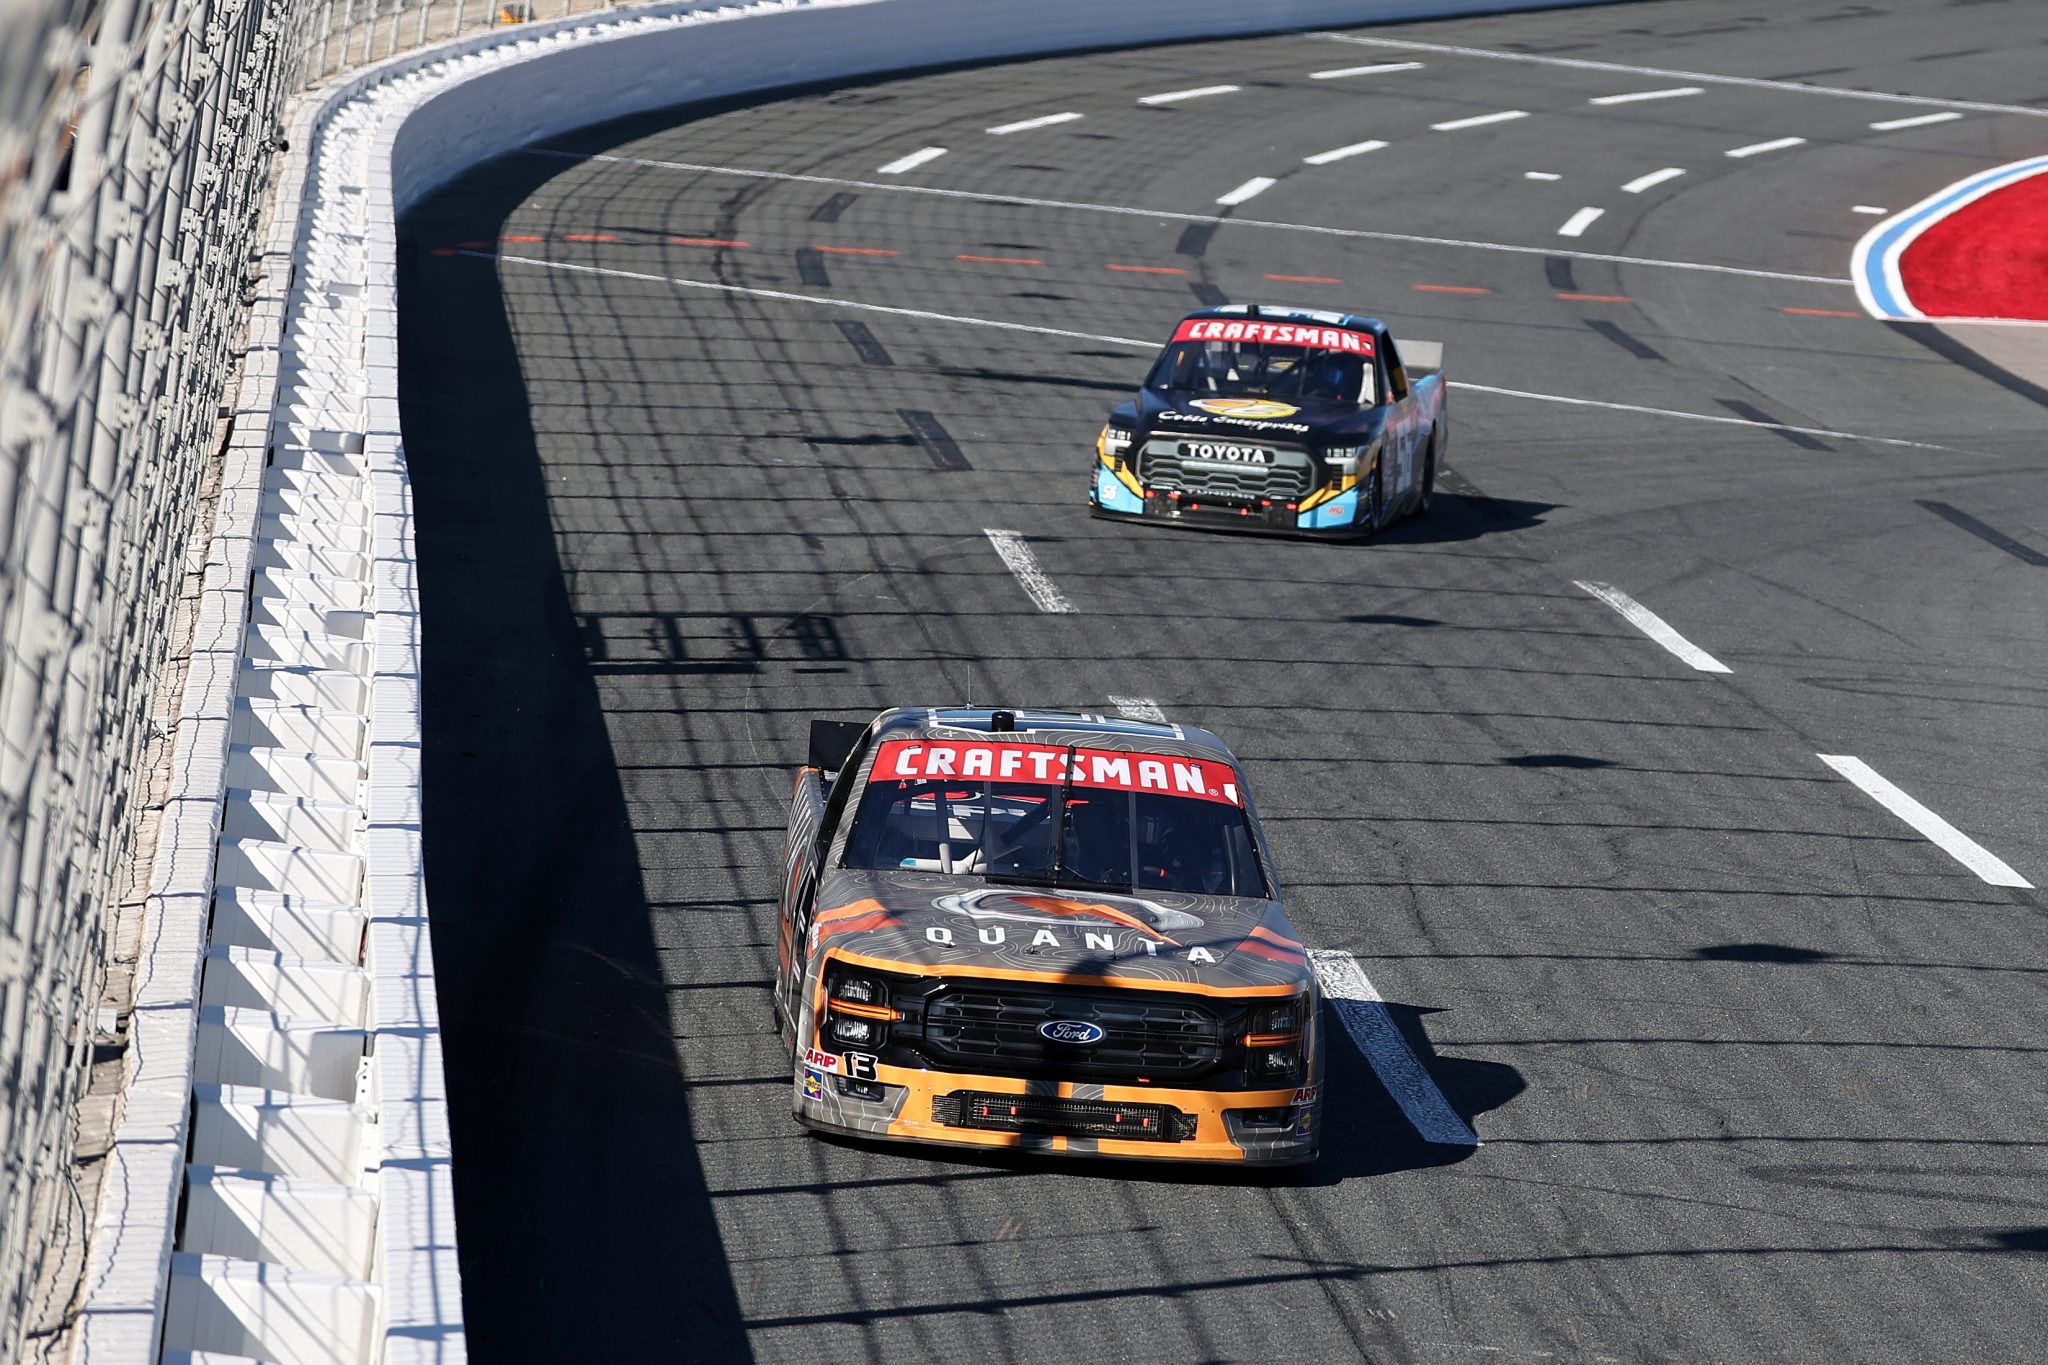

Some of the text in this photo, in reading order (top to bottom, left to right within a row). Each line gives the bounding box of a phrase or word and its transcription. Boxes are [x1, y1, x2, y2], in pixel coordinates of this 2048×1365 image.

[1189, 321, 1361, 351] CRAFTSMAN
[1213, 416, 1310, 432] Enterprises
[1187, 443, 1266, 463] TOYOTA
[926, 927, 1216, 964] QUANTA
[1052, 1023, 1090, 1041] Ford
[805, 1049, 837, 1068] ARP
[842, 1051, 878, 1082] 13
